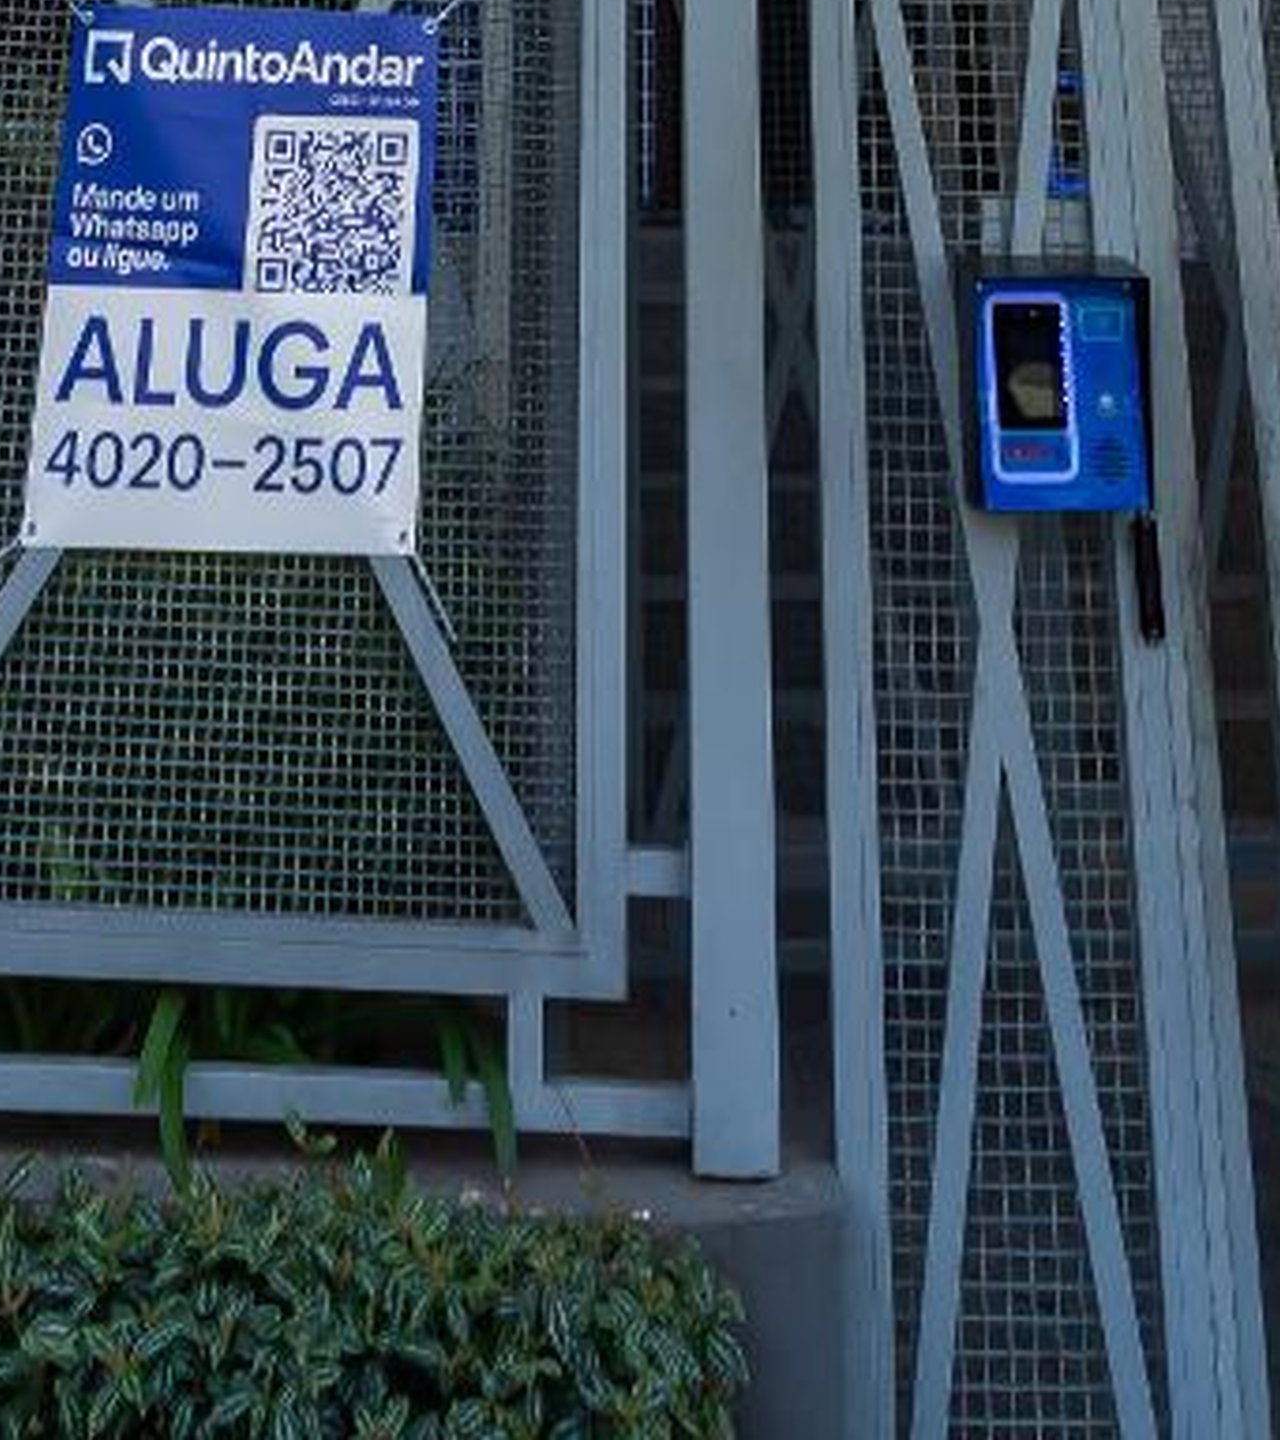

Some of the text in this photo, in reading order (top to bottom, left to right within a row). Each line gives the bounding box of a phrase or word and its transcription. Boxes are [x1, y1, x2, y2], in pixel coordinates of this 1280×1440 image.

[140, 36, 424, 87] QuintoAndar
[73, 182, 200, 212] Mande um
[69, 212, 199, 248] Whatsapp
[66, 242, 171, 275] ou ligue.
[54, 314, 404, 411] ALUGA
[45, 430, 405, 495] 4020-2507
